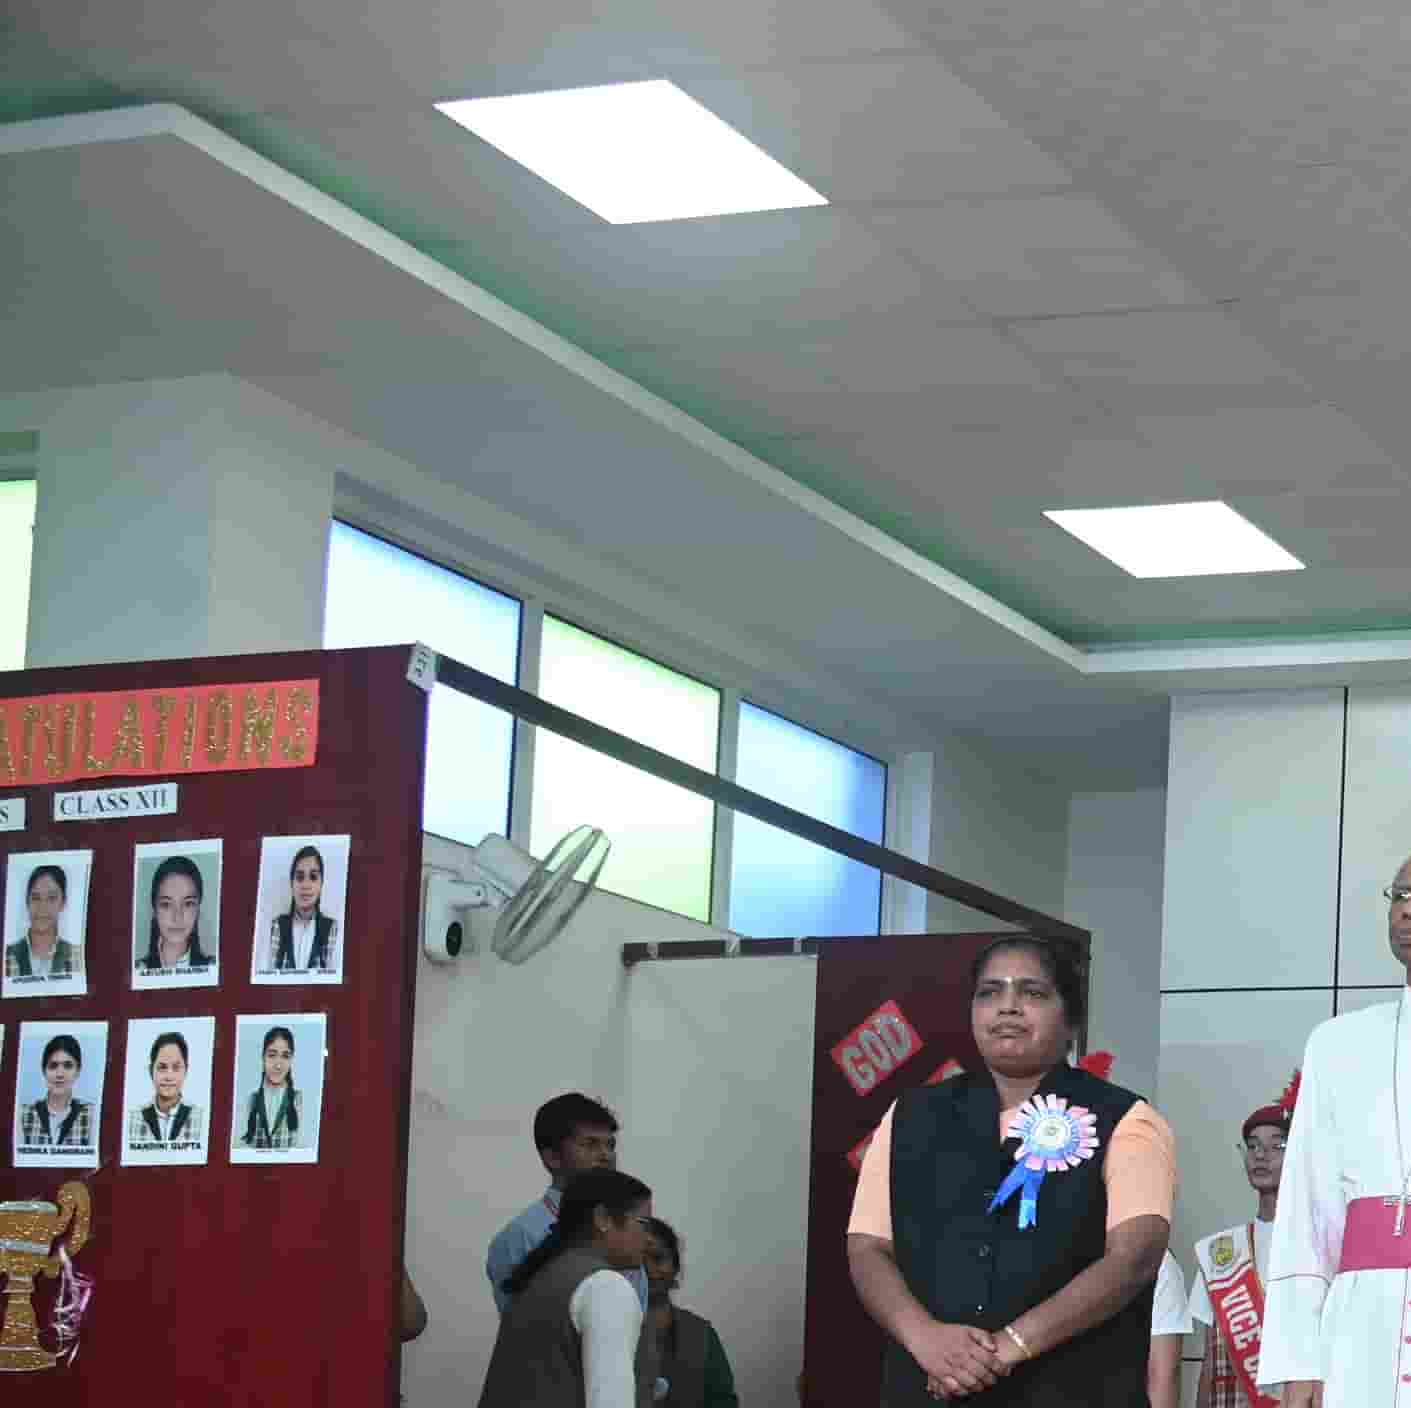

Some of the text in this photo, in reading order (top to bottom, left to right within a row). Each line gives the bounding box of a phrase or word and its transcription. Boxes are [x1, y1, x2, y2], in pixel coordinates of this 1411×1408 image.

[60, 788, 168, 815] CLASS XII
[1221, 1284, 1262, 1350] VICE
